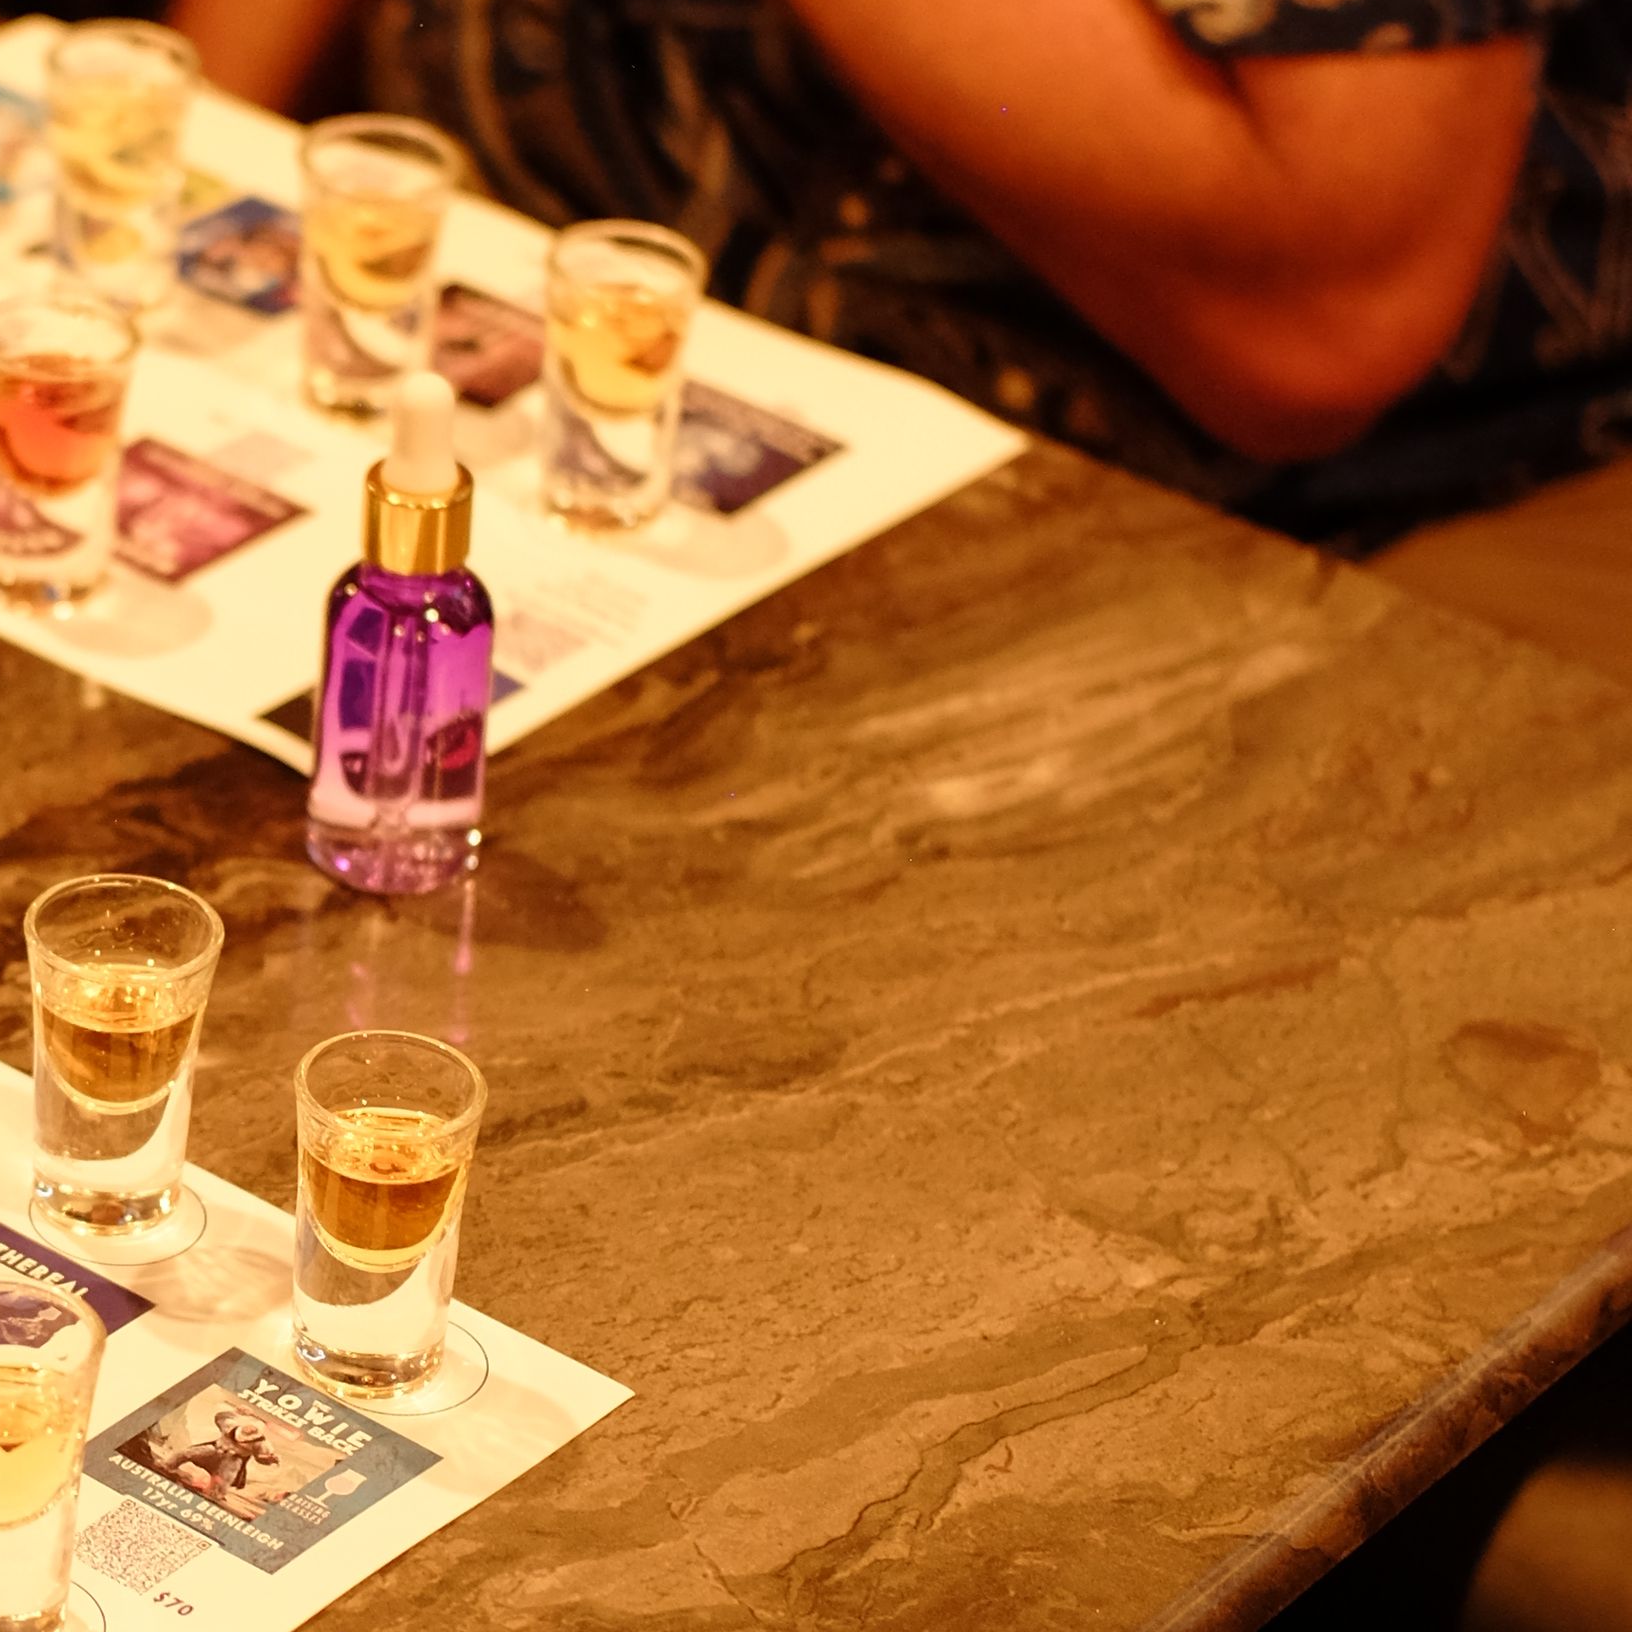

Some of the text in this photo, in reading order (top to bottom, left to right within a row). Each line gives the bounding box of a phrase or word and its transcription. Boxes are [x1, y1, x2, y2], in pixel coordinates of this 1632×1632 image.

[237, 1389, 359, 1456] STRIKES BACK
[254, 1378, 373, 1449] YOWIE
[108, 1454, 285, 1550] AUSTRALIA BEENLEIGH
[180, 1508, 216, 1530] 69%
[153, 1591, 194, 1616] $70
